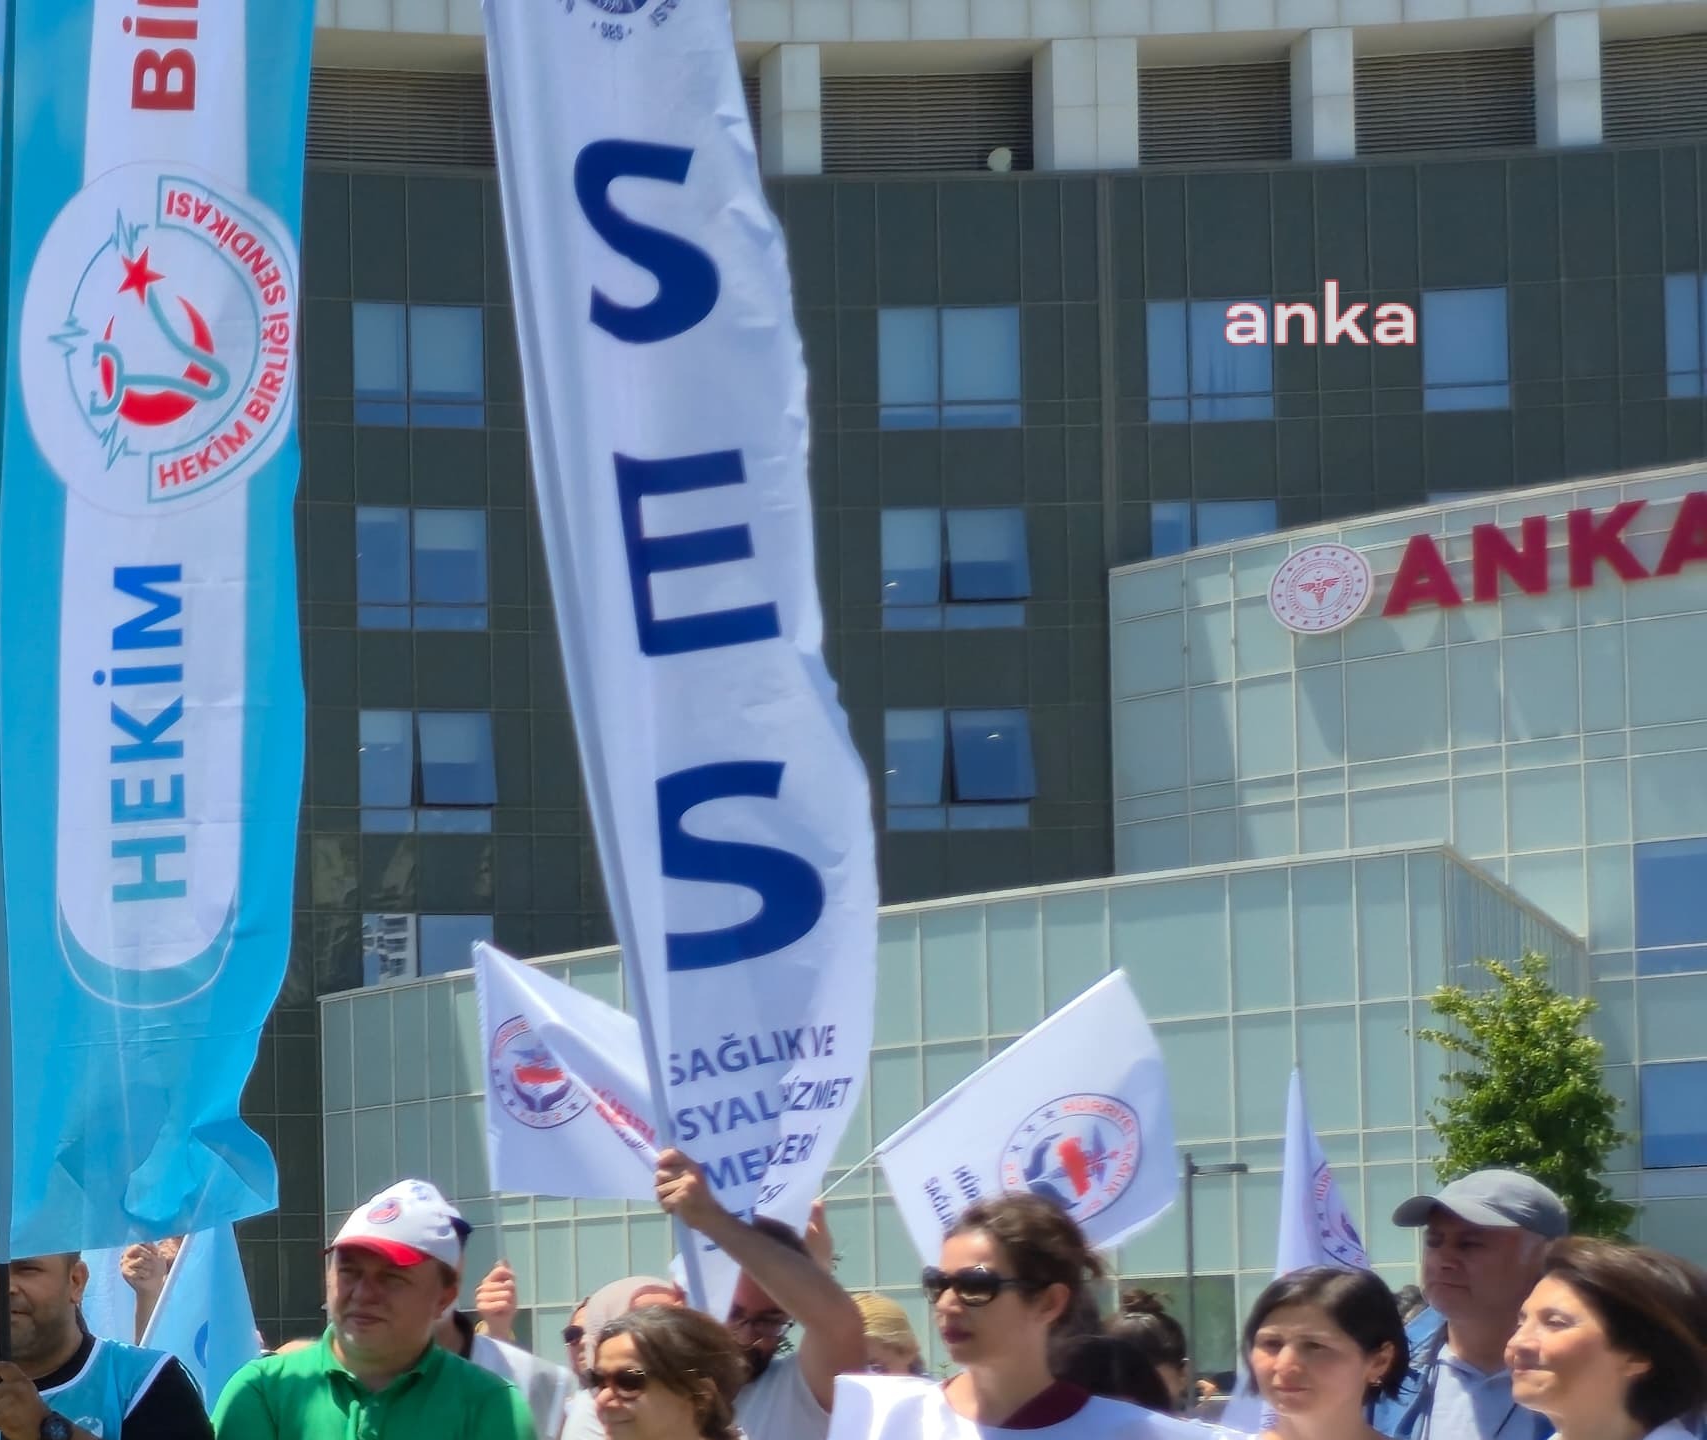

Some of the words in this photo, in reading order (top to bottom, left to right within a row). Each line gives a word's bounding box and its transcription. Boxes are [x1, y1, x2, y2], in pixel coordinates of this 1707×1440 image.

[165, 189, 286, 303] SENDİKASI
[245, 310, 290, 424] BİRLİĞİ
[158, 422, 253, 490] HEKİM
[92, 562, 187, 902] HEKİM
[673, 1090, 780, 1141] SYAL
